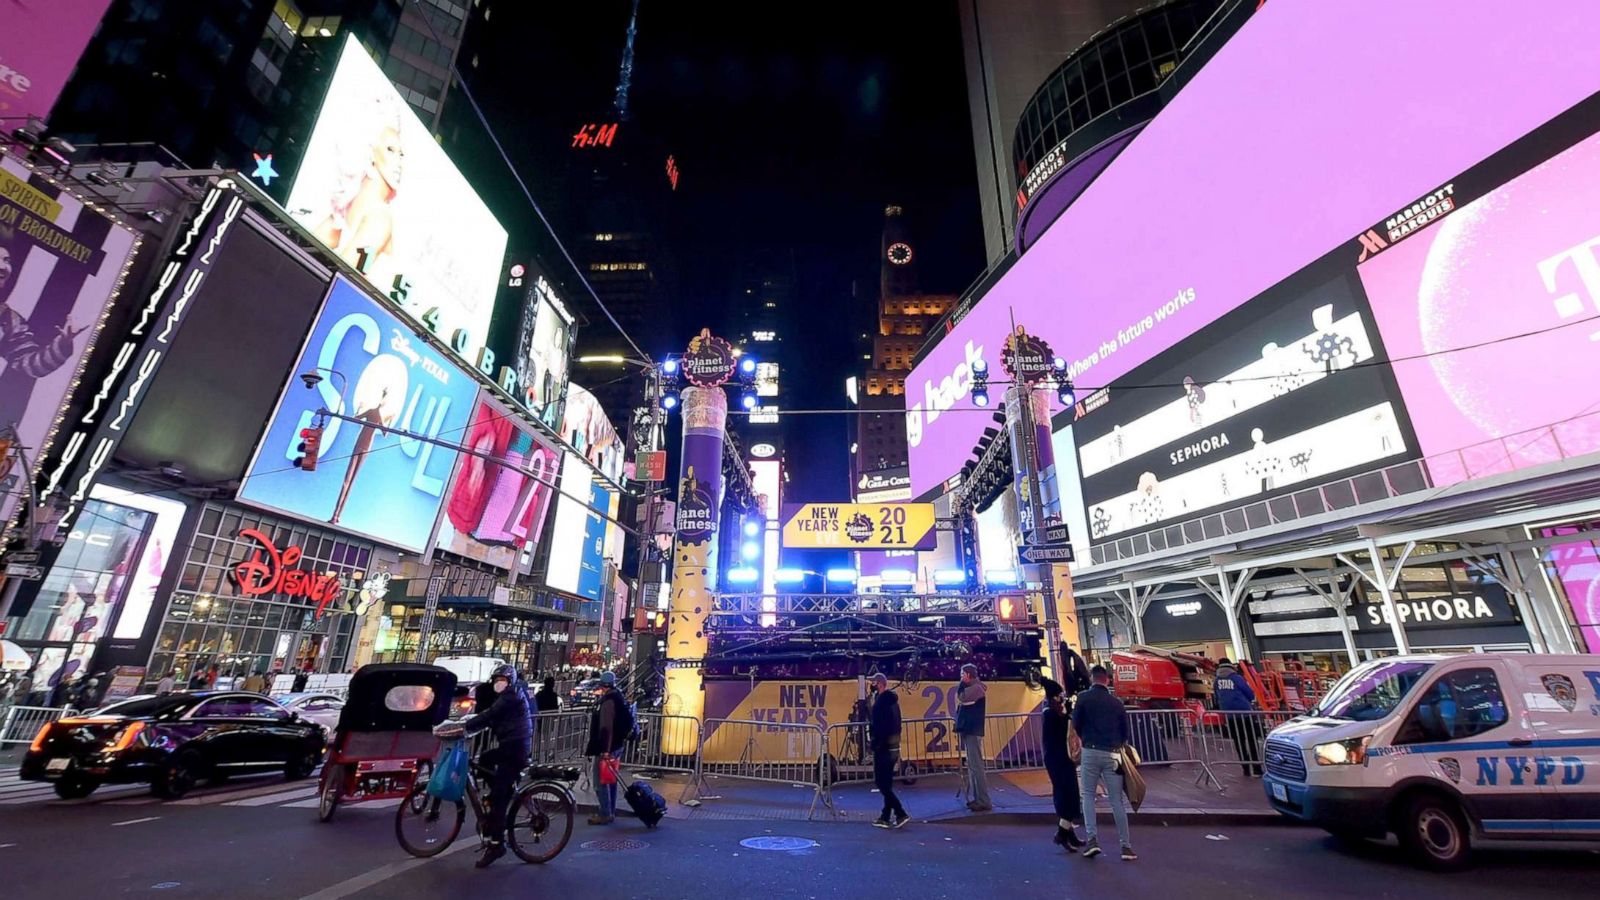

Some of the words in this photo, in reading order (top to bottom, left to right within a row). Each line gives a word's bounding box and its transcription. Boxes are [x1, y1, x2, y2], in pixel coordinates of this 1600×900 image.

[572, 123, 617, 147] H&M
[1026, 142, 1067, 187] MARRIOTT
[1028, 157, 1063, 196] MARQUIS
[2, 178, 51, 217] SPIRITS
[1386, 183, 1454, 230] MARRIOTT
[1390, 200, 1451, 240] MARQUIS
[0, 203, 20, 224] ON
[19, 215, 92, 264] BROADWAY!
[508, 278, 523, 287] LG
[1067, 352, 1099, 380] Where
[1099, 340, 1118, 359] the
[1117, 315, 1154, 348] future
[1154, 287, 1196, 323] works
[687, 357, 723, 369] planet
[691, 364, 731, 374] fitness
[1006, 355, 1044, 366] planet
[1012, 363, 1052, 372] ftness
[285, 312, 452, 498] SOUL
[475, 347, 628, 489] BROADY
[1169, 432, 1230, 465] SEPHORA
[797, 519, 840, 531] YEAR'S
[811, 507, 839, 519] NEW
[879, 507, 906, 525] 20
[880, 526, 907, 544] 21
[1047, 529, 1066, 540] WAY
[1027, 549, 1042, 559] ONE
[1050, 549, 1067, 558] WAY
[1367, 596, 1494, 625] SEPHORA
[779, 684, 828, 708] NEW
[753, 708, 828, 735] YEAR'S
[1377, 745, 1410, 757] POLICE
[1475, 755, 1585, 786] NYPD
